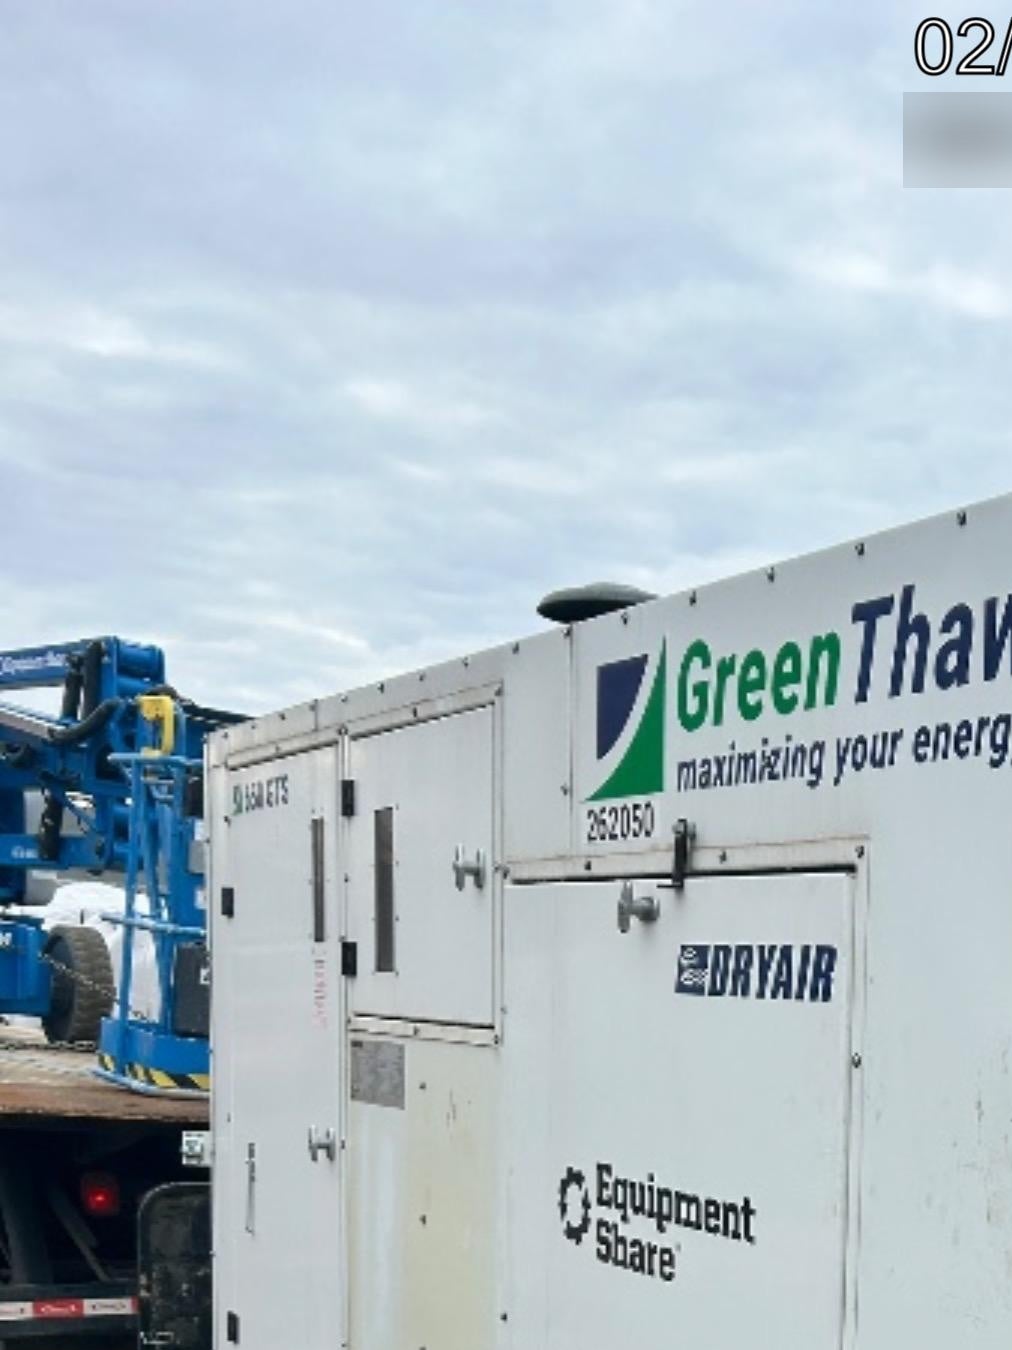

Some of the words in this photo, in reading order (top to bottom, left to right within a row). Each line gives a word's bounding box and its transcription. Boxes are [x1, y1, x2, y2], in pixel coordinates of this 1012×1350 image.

[677, 734, 825, 792] maximizing
[833, 728, 904, 787] your
[586, 801, 655, 841] 262050
[707, 944, 838, 1002] DRYAIR
[596, 1162, 756, 1243] Equipment
[596, 1218, 676, 1281] Share
